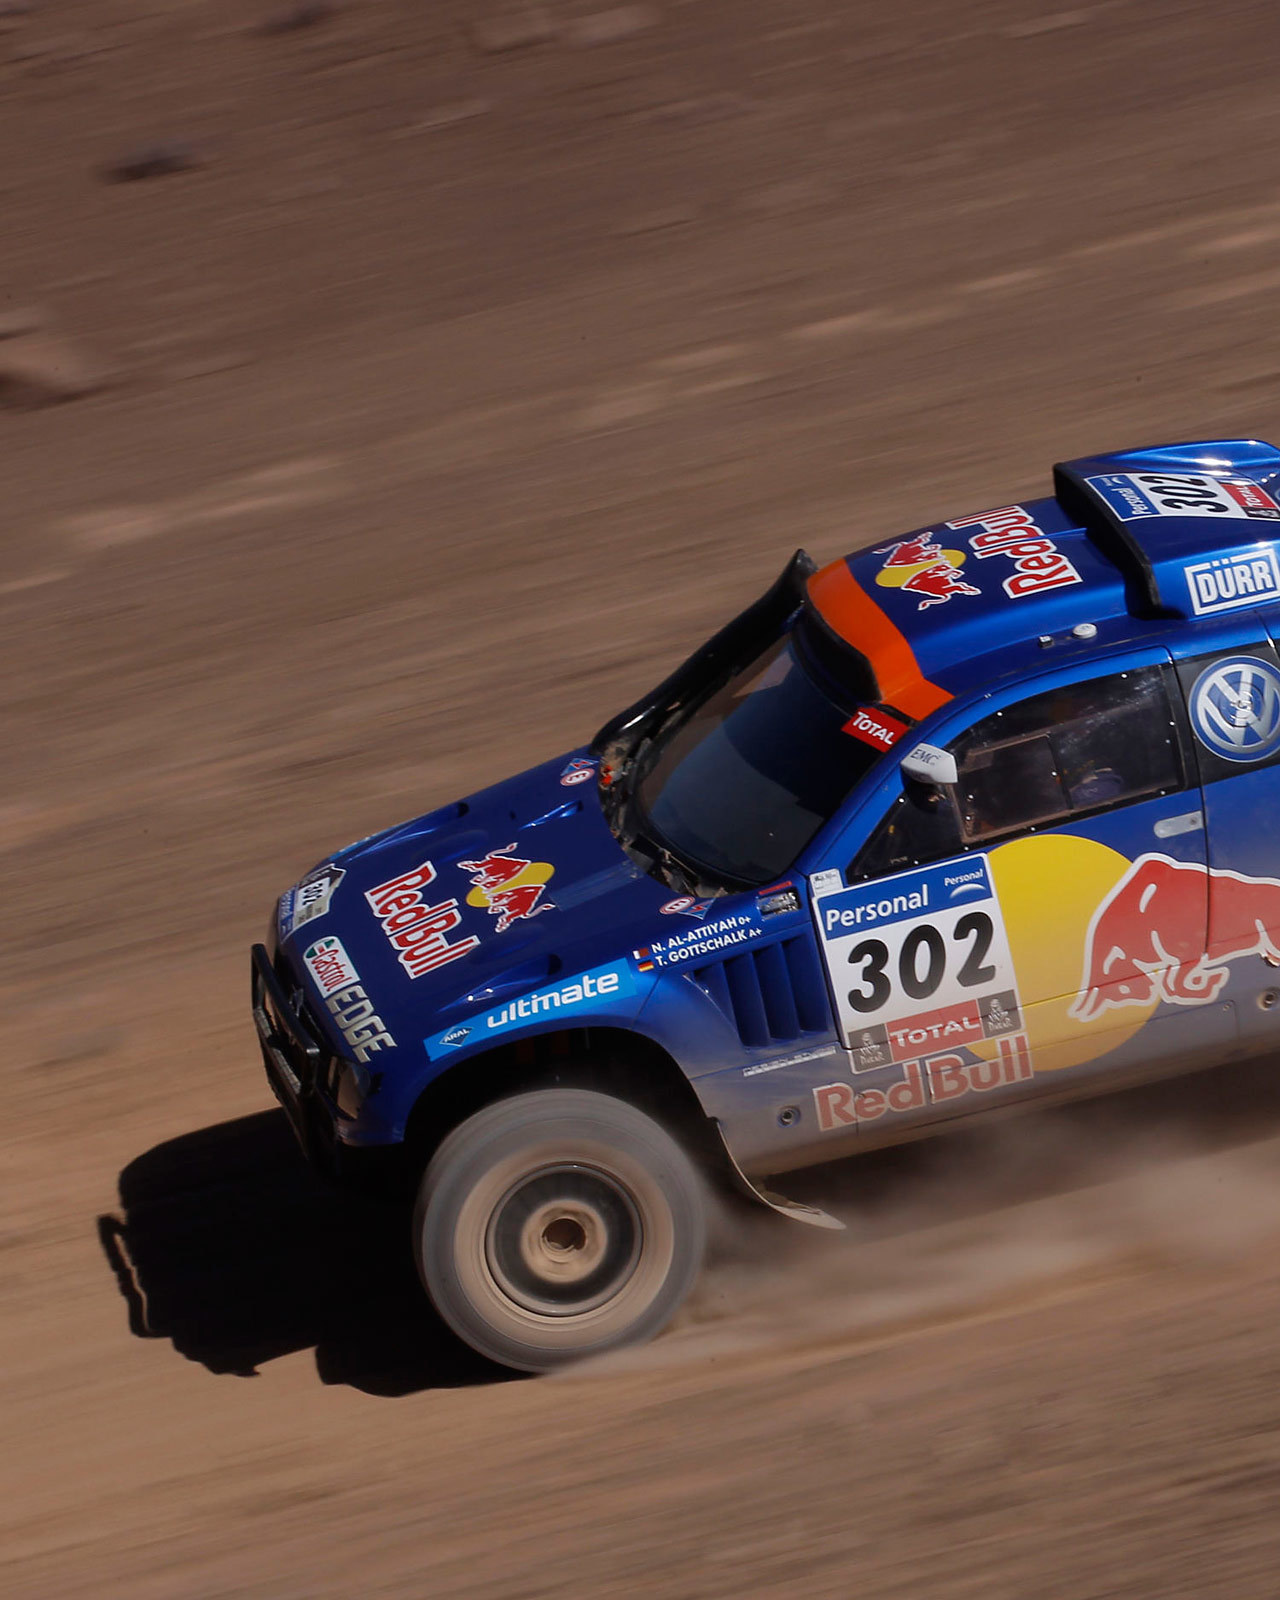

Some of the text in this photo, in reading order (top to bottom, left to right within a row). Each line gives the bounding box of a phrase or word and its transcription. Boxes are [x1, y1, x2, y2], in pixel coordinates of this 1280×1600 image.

[1138, 475, 1229, 513] 302
[944, 505, 1083, 599] Red Bull
[1195, 558, 1275, 604] DÜRR
[852, 711, 895, 745] TOTAL
[944, 868, 984, 887] Personal
[364, 861, 481, 980] Red Bull
[826, 884, 929, 931] Personal
[651, 942, 667, 954] N.
[668, 917, 737, 949] AL-ATTIYAH
[655, 927, 763, 967] T. GOTTSCHALK A+
[311, 948, 353, 992] Castrol
[847, 911, 997, 1013] 302
[487, 972, 620, 1028] ultimate
[325, 985, 398, 1063] EDGE
[443, 1028, 471, 1042] ARAL
[889, 1016, 981, 1048] TOTAL
[813, 1060, 927, 1132] Red
[925, 1032, 1034, 1104] Bull
